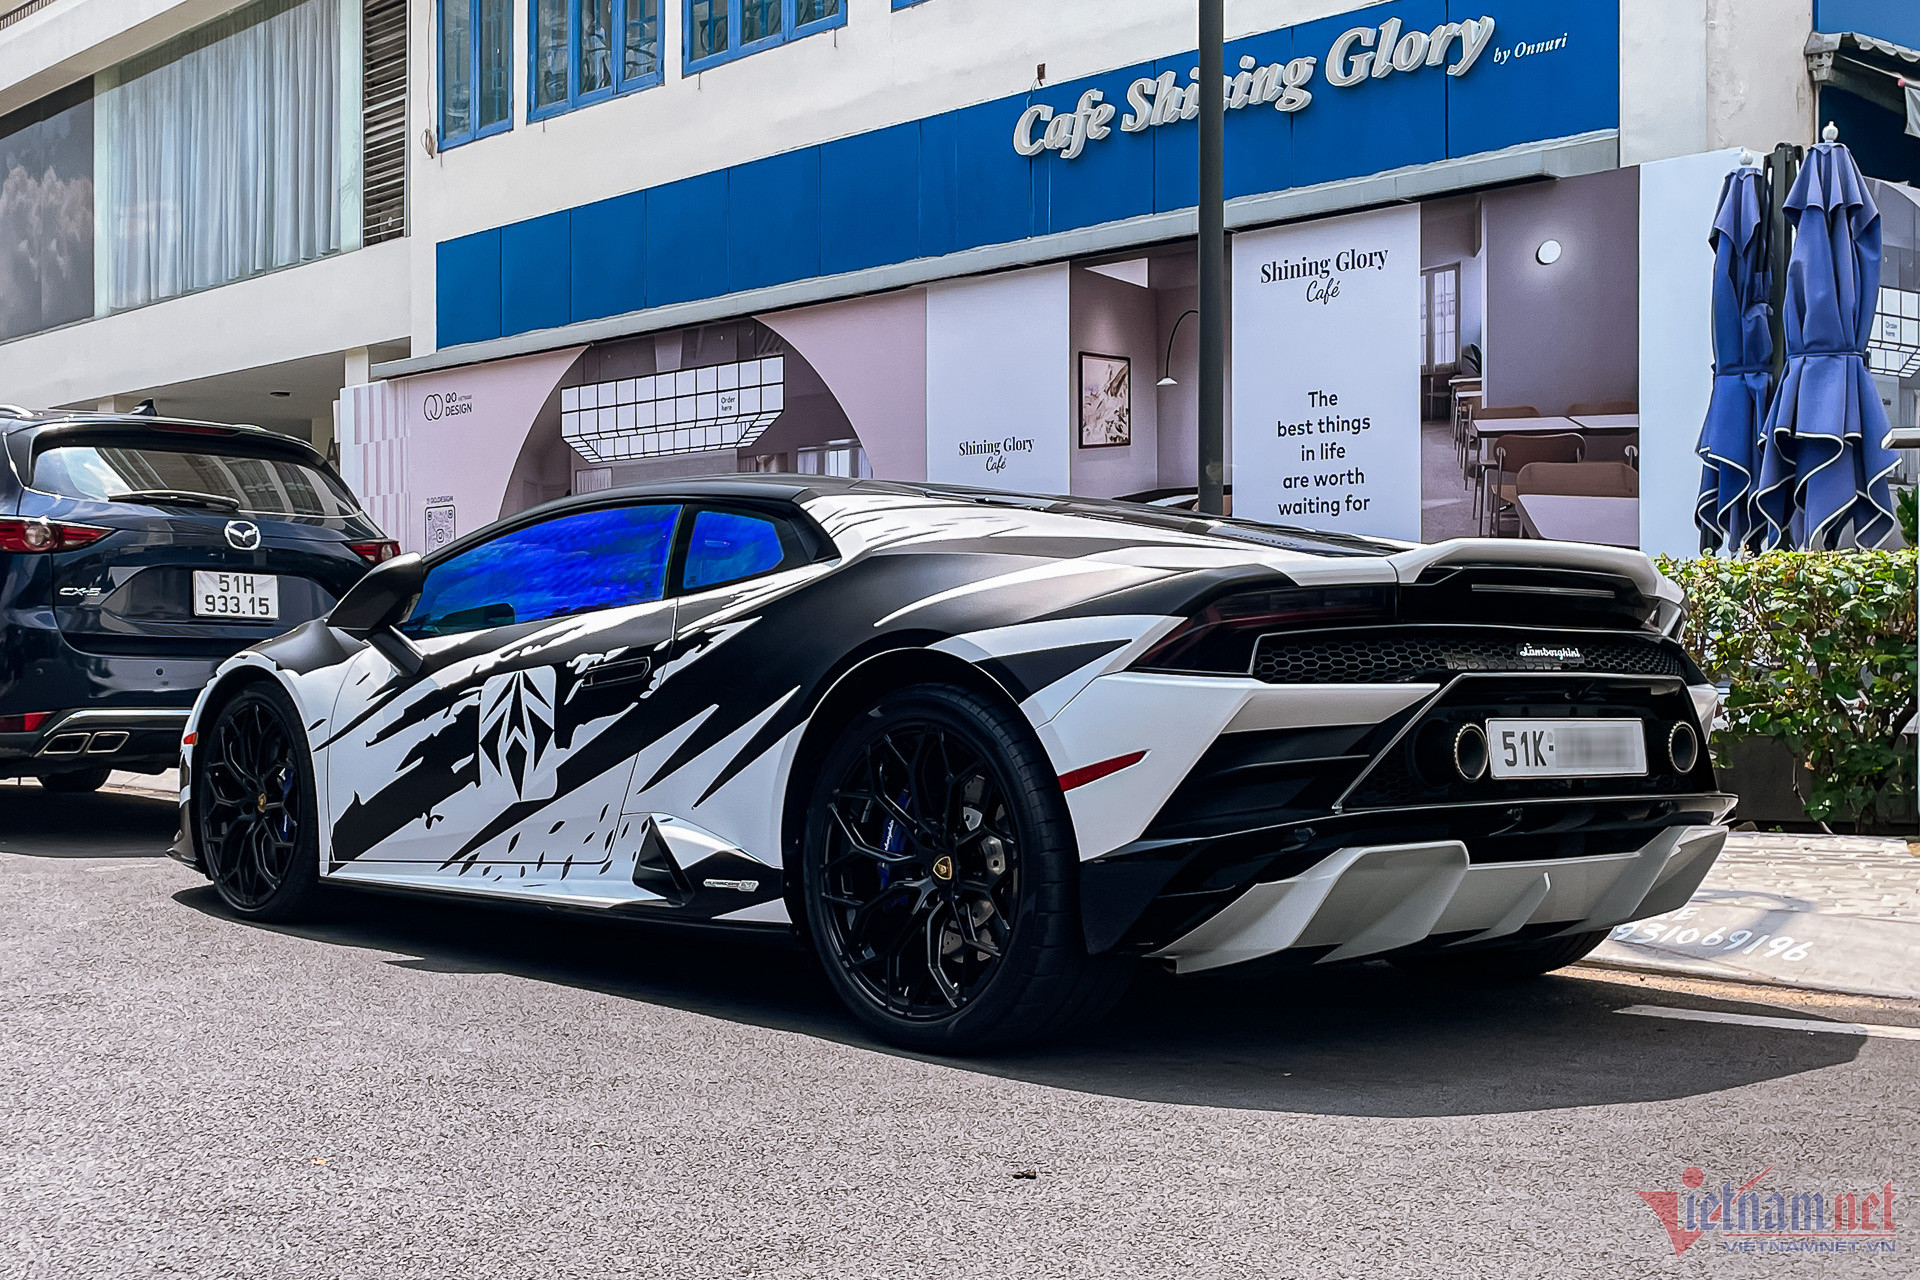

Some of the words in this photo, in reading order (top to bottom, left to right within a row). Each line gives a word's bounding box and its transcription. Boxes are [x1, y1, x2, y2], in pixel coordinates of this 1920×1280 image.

[1493, 46, 1511, 66] by
[1514, 32, 1568, 58] Onnuri
[1013, 90, 1115, 160] Cafe
[1120, 55, 1317, 133] Shiing
[1325, 16, 1495, 88] Glory
[1260, 255, 1331, 284] Shining
[1336, 248, 1389, 272] Glory
[1306, 278, 1341, 304] Café
[445, 403, 472, 416] DESIGN
[1308, 390, 1338, 408] The
[1277, 421, 1313, 437] best
[1317, 415, 1371, 435] things
[959, 439, 1001, 456] Shining
[1003, 436, 1034, 453] Glory
[1301, 445, 1315, 461] in
[1320, 443, 1346, 460] life
[1283, 473, 1309, 489] are
[1314, 467, 1365, 487] worth
[1278, 497, 1340, 517] waiting
[1345, 495, 1371, 512] for
[59, 587, 102, 596] CX-5
[218, 574, 255, 595] 51H
[204, 594, 270, 616] 933.15
[1519, 643, 1581, 661] Lamborghini
